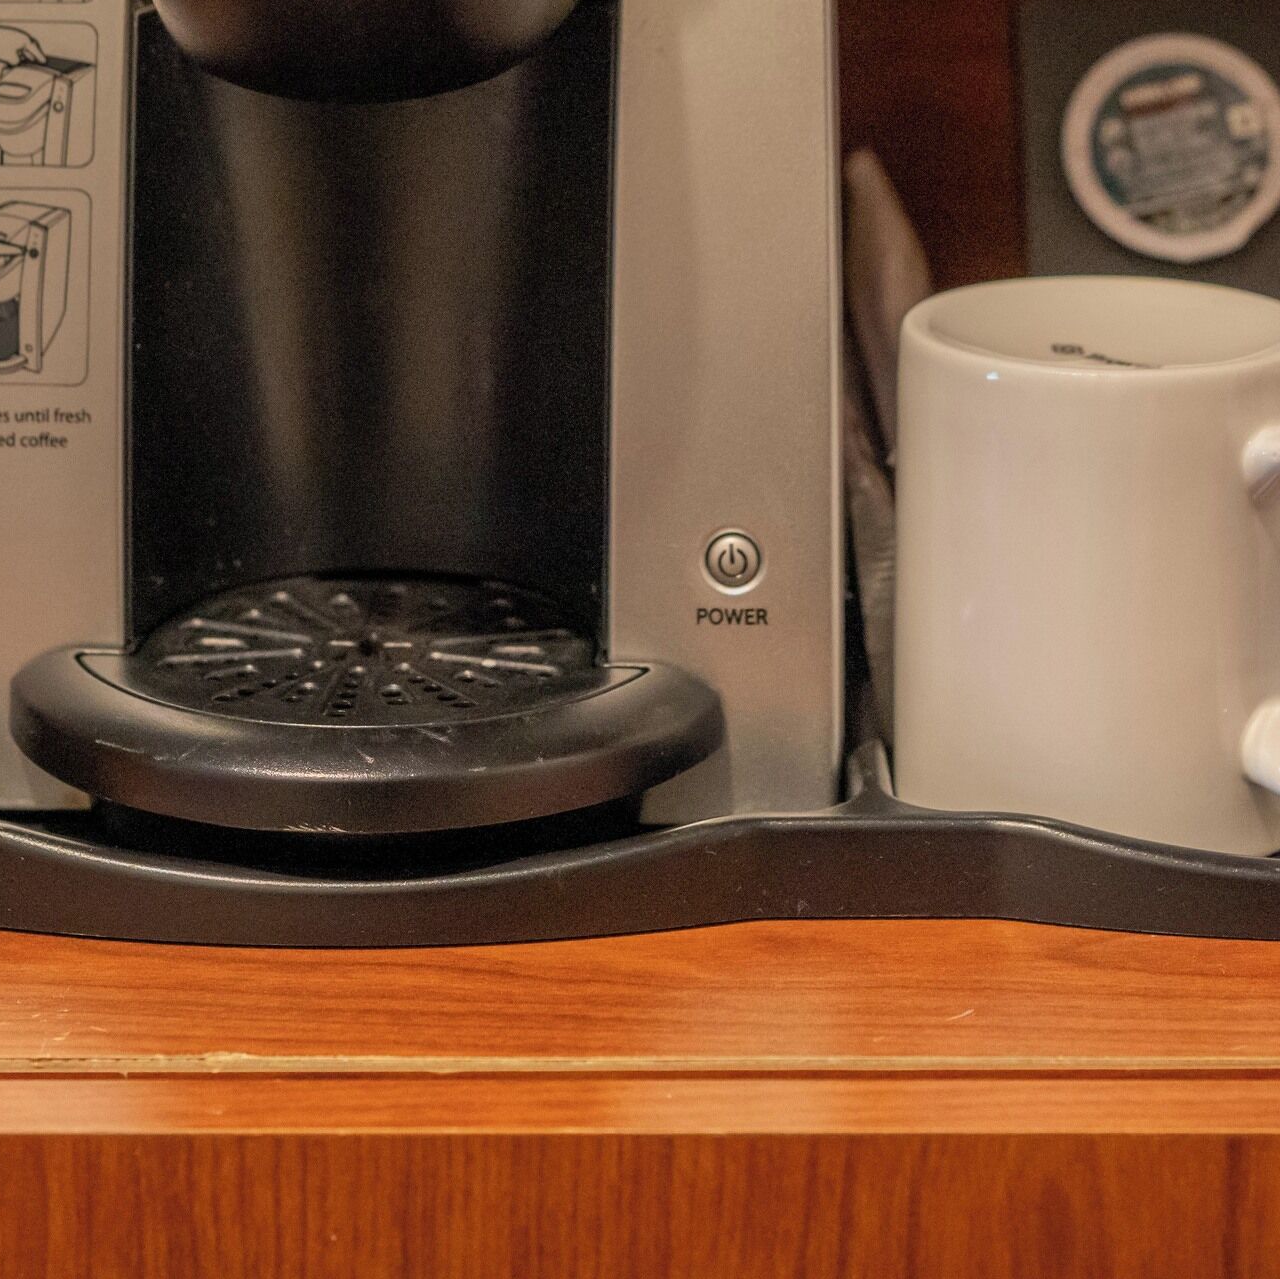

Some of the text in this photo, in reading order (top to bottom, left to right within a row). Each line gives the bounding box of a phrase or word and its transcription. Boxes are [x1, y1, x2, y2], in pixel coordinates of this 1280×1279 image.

[14, 408, 50, 423] until
[54, 407, 93, 424] fresh
[20, 431, 70, 449] coffee
[696, 607, 769, 626] POWER
